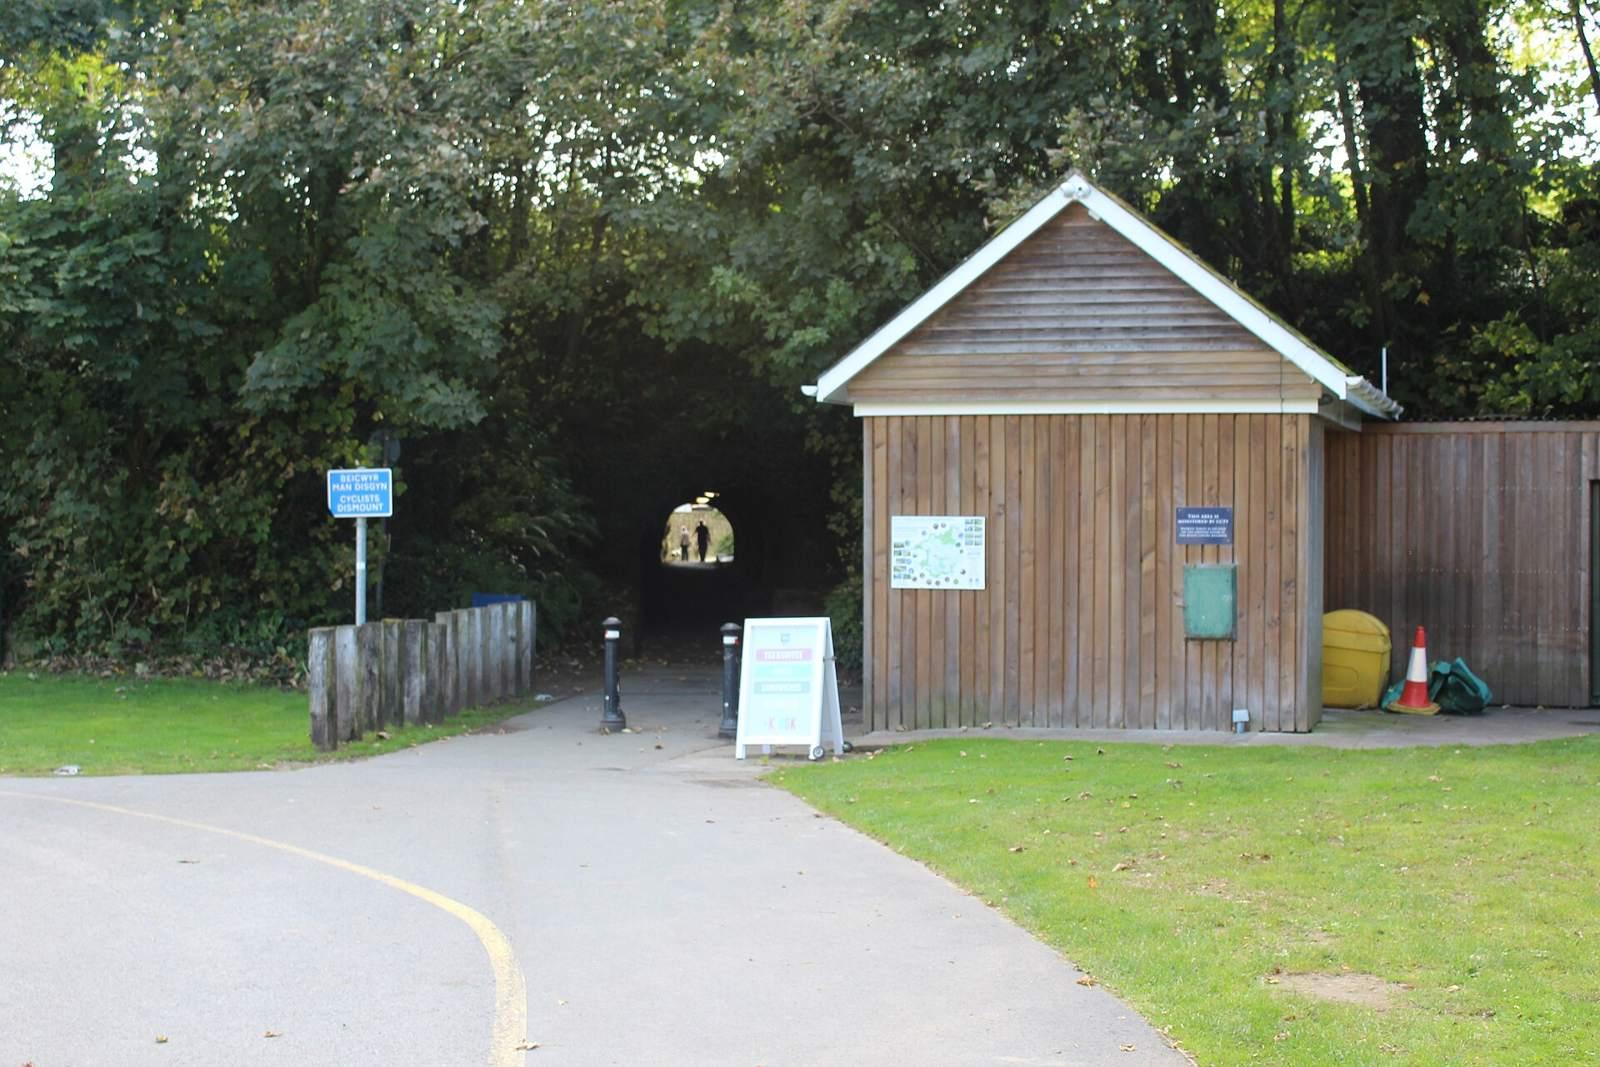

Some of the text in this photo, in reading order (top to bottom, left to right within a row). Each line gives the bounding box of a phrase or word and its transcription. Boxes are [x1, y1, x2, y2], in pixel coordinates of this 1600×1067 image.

[340, 474, 379, 482] BEICWYR
[332, 482, 388, 491] MAN DISGYN
[340, 494, 380, 503] CYCLISTS
[337, 503, 384, 512] DISMOUNT
